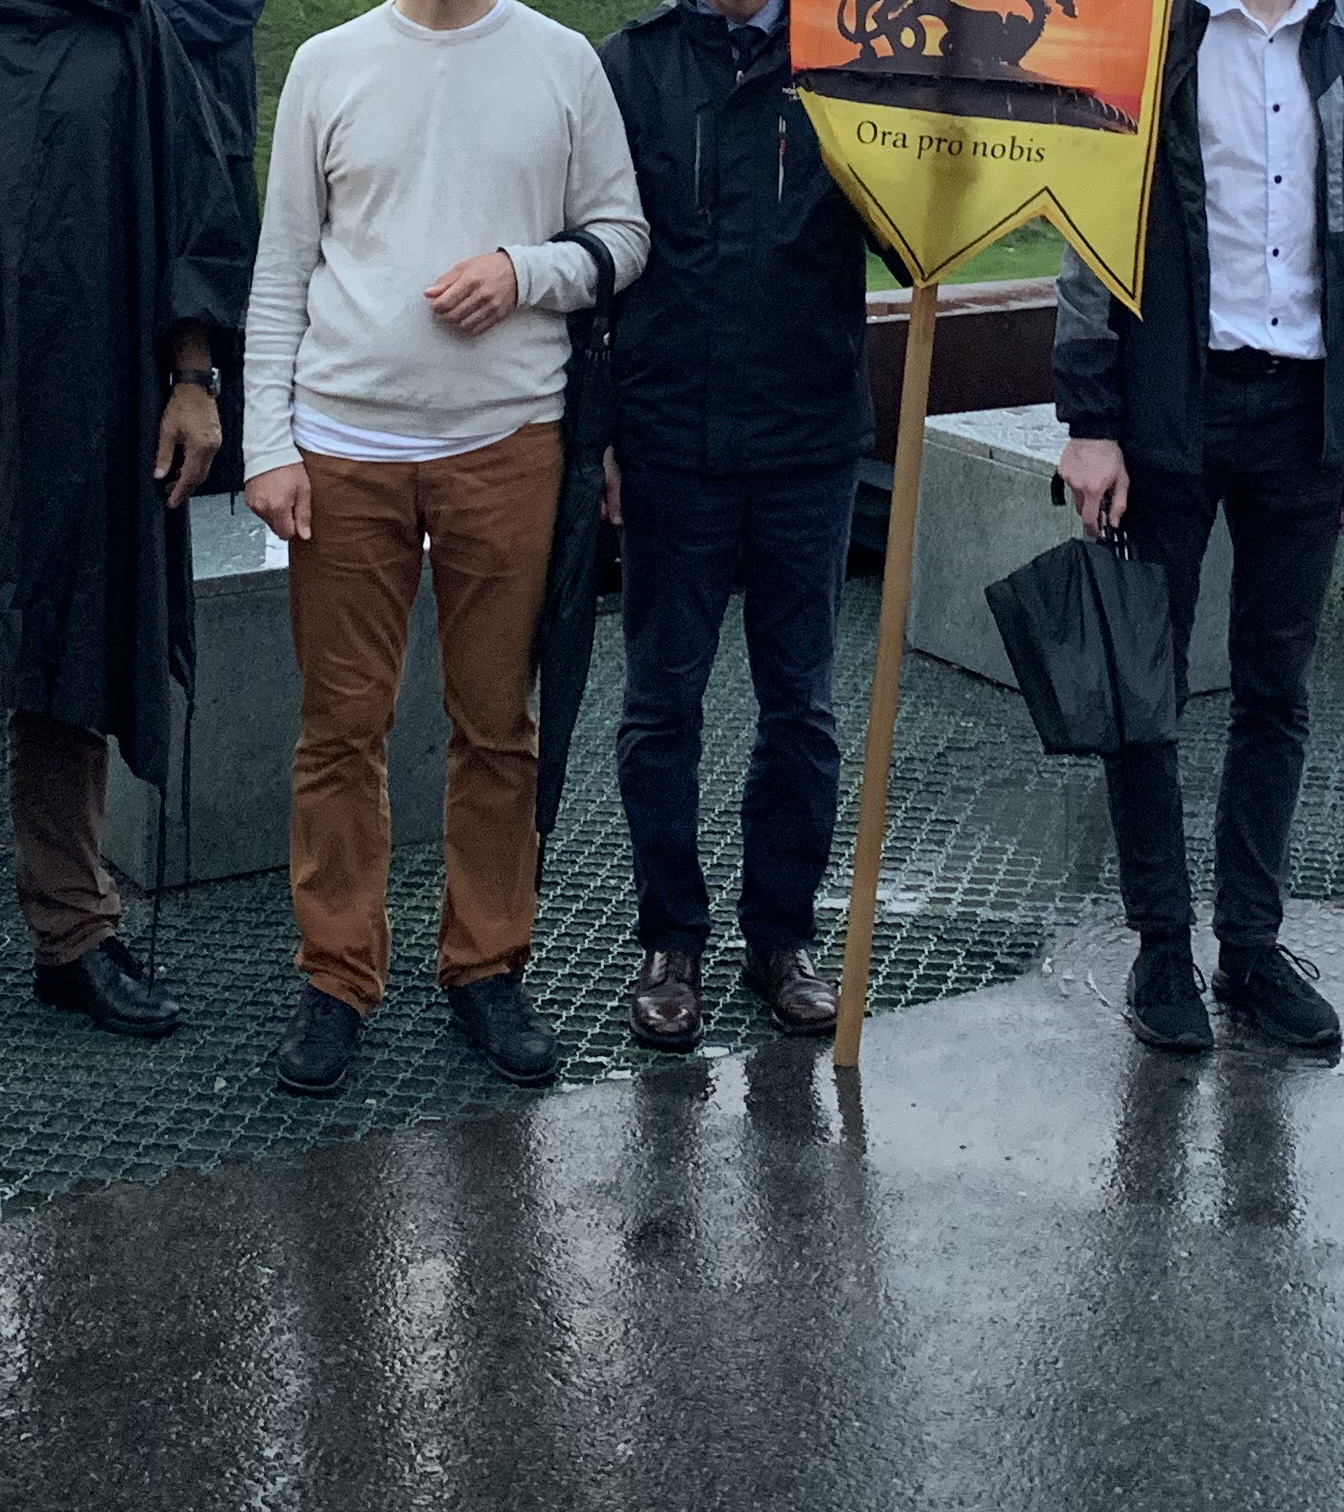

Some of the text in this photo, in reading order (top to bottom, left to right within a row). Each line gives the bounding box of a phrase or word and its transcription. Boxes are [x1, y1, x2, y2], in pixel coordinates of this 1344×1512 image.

[856, 119, 1046, 163] Ora pro nobis
